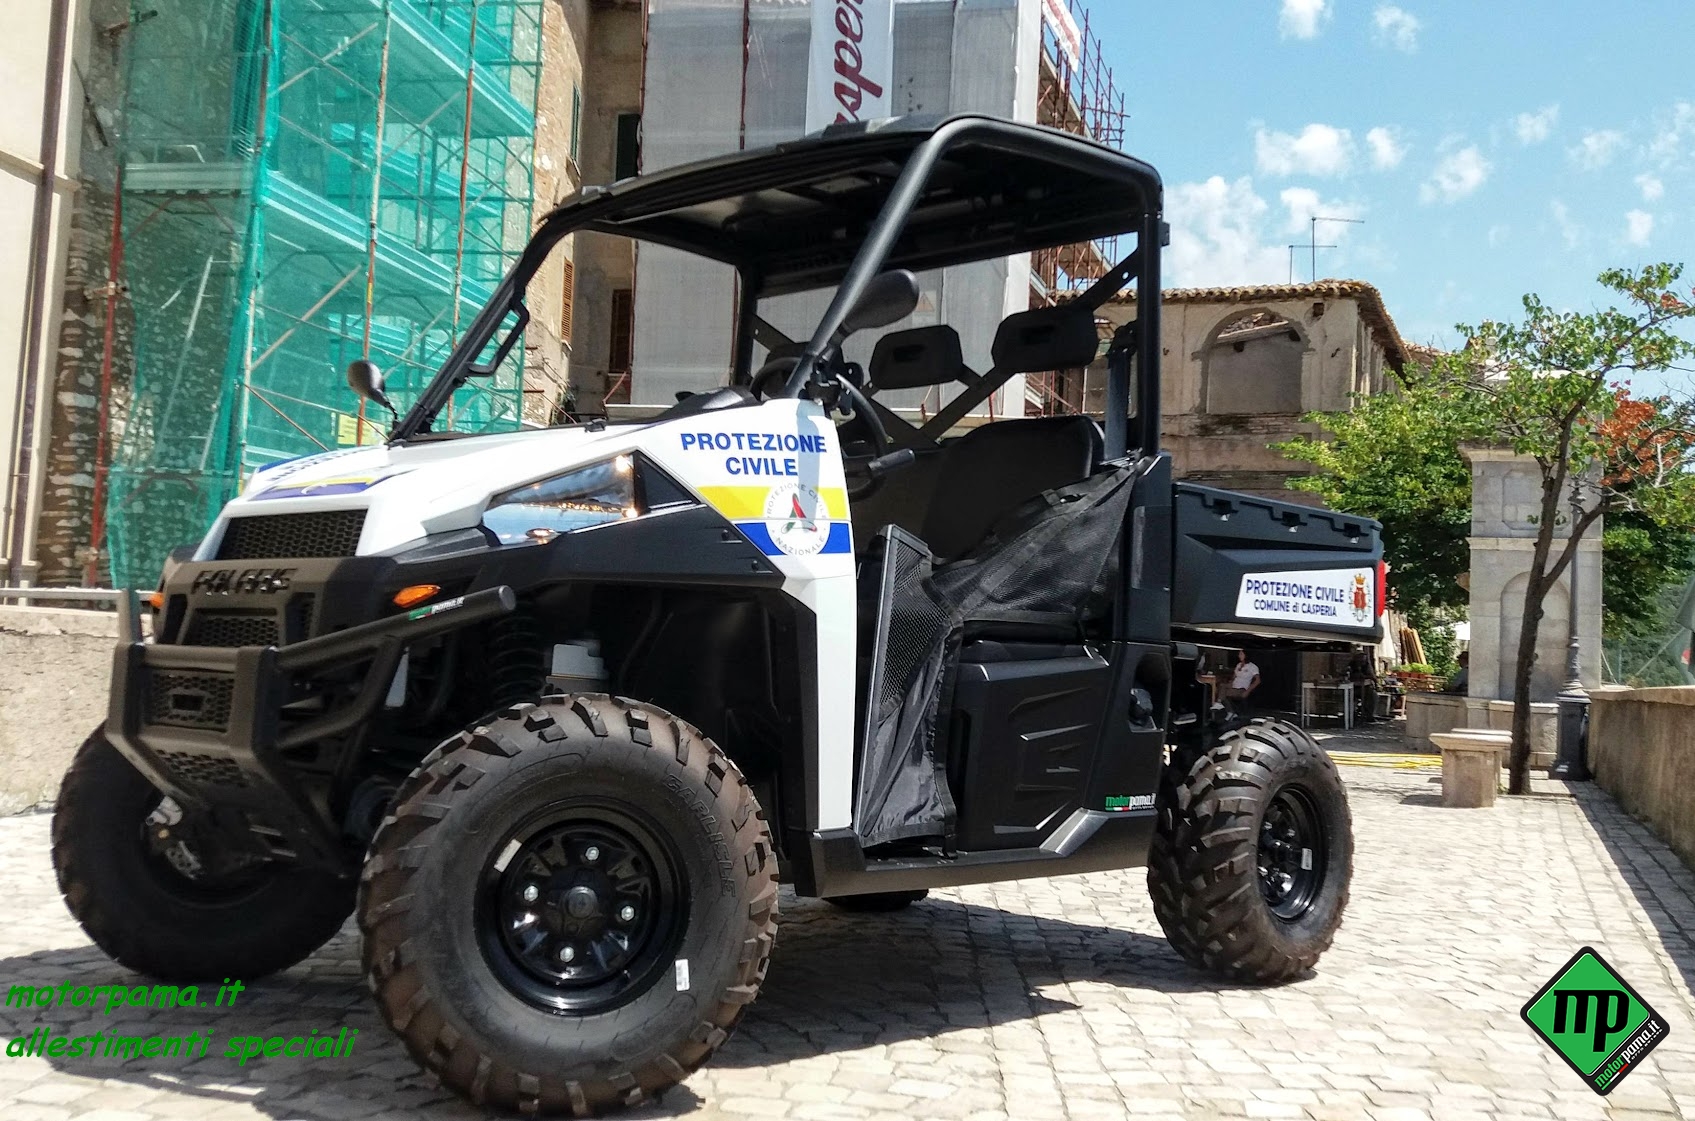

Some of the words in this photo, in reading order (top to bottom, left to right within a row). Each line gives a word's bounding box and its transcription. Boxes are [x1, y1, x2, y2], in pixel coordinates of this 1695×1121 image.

[680, 432, 827, 453] PROTEZIONE
[725, 456, 798, 476] CIVILE
[775, 535, 825, 556] NAZIONALE
[1245, 578, 1312, 600] PROTEZIONE
[1315, 586, 1344, 603] CIVILE
[1253, 598, 1290, 613] COMUNE
[1292, 602, 1299, 613] di
[1301, 602, 1338, 617] CASPERIA
[662, 773, 736, 897] CARLISLE
